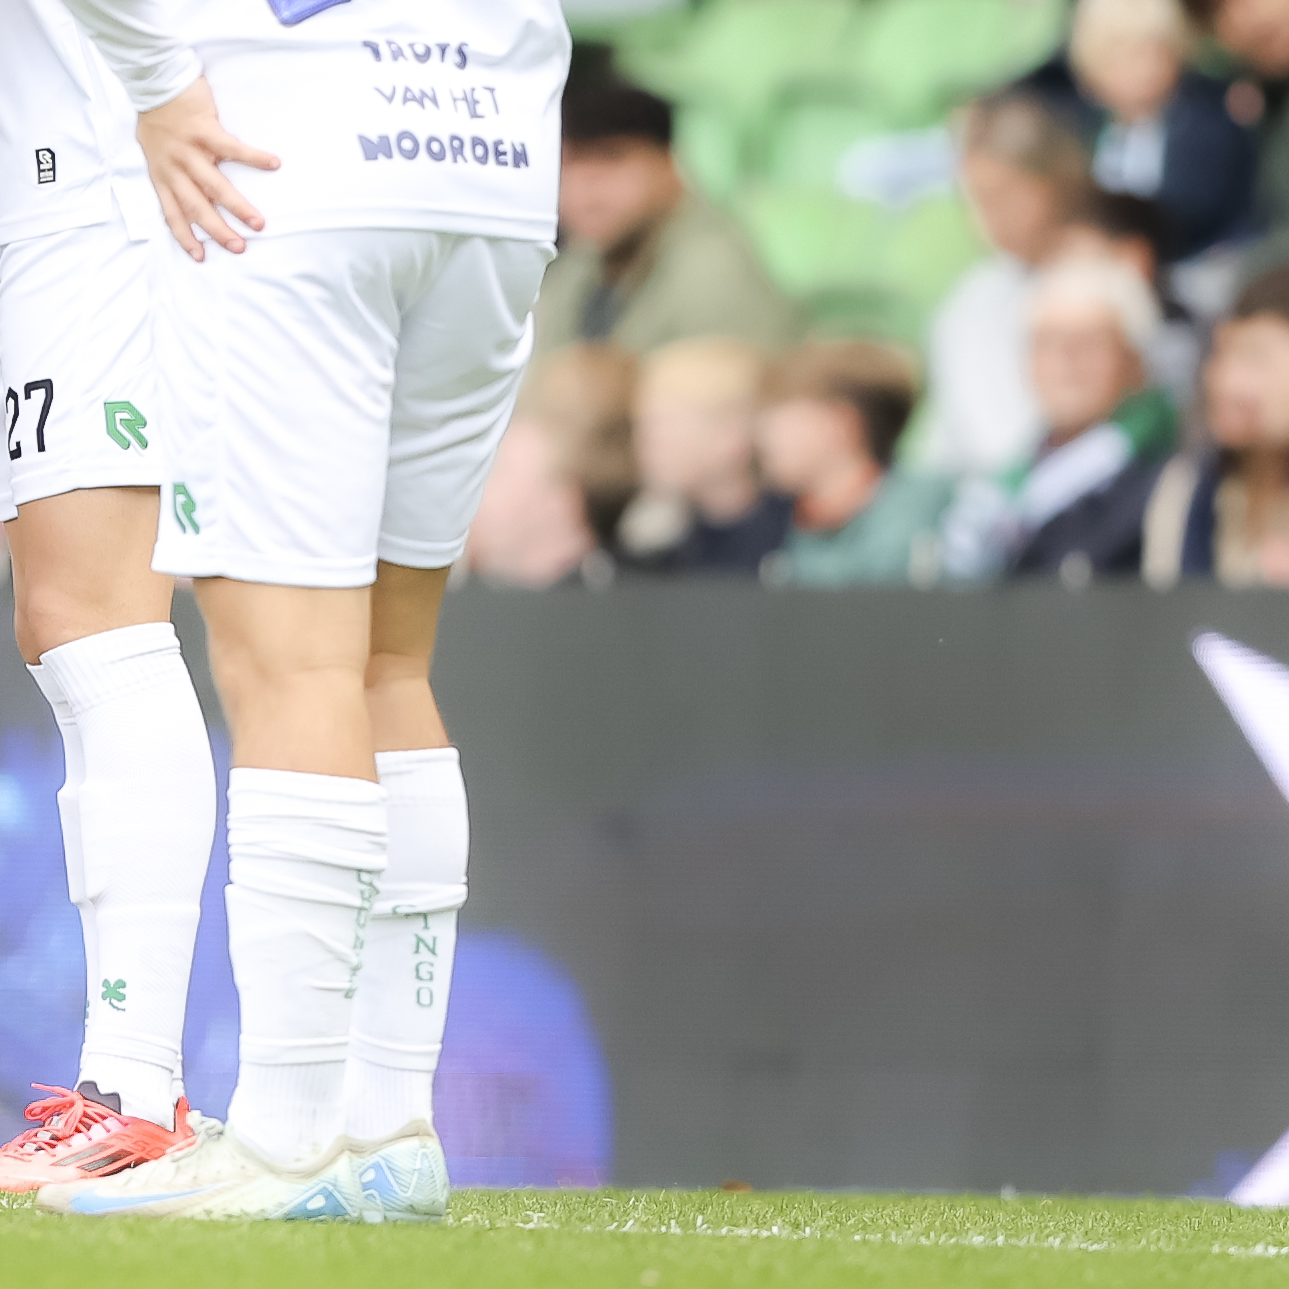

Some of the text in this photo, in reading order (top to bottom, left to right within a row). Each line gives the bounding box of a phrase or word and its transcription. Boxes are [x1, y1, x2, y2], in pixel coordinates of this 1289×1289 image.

[361, 40, 469, 70] TROTS
[373, 84, 500, 119] VAN HET
[357, 130, 529, 168] NOORDEN
[5, 378, 54, 461] 27
